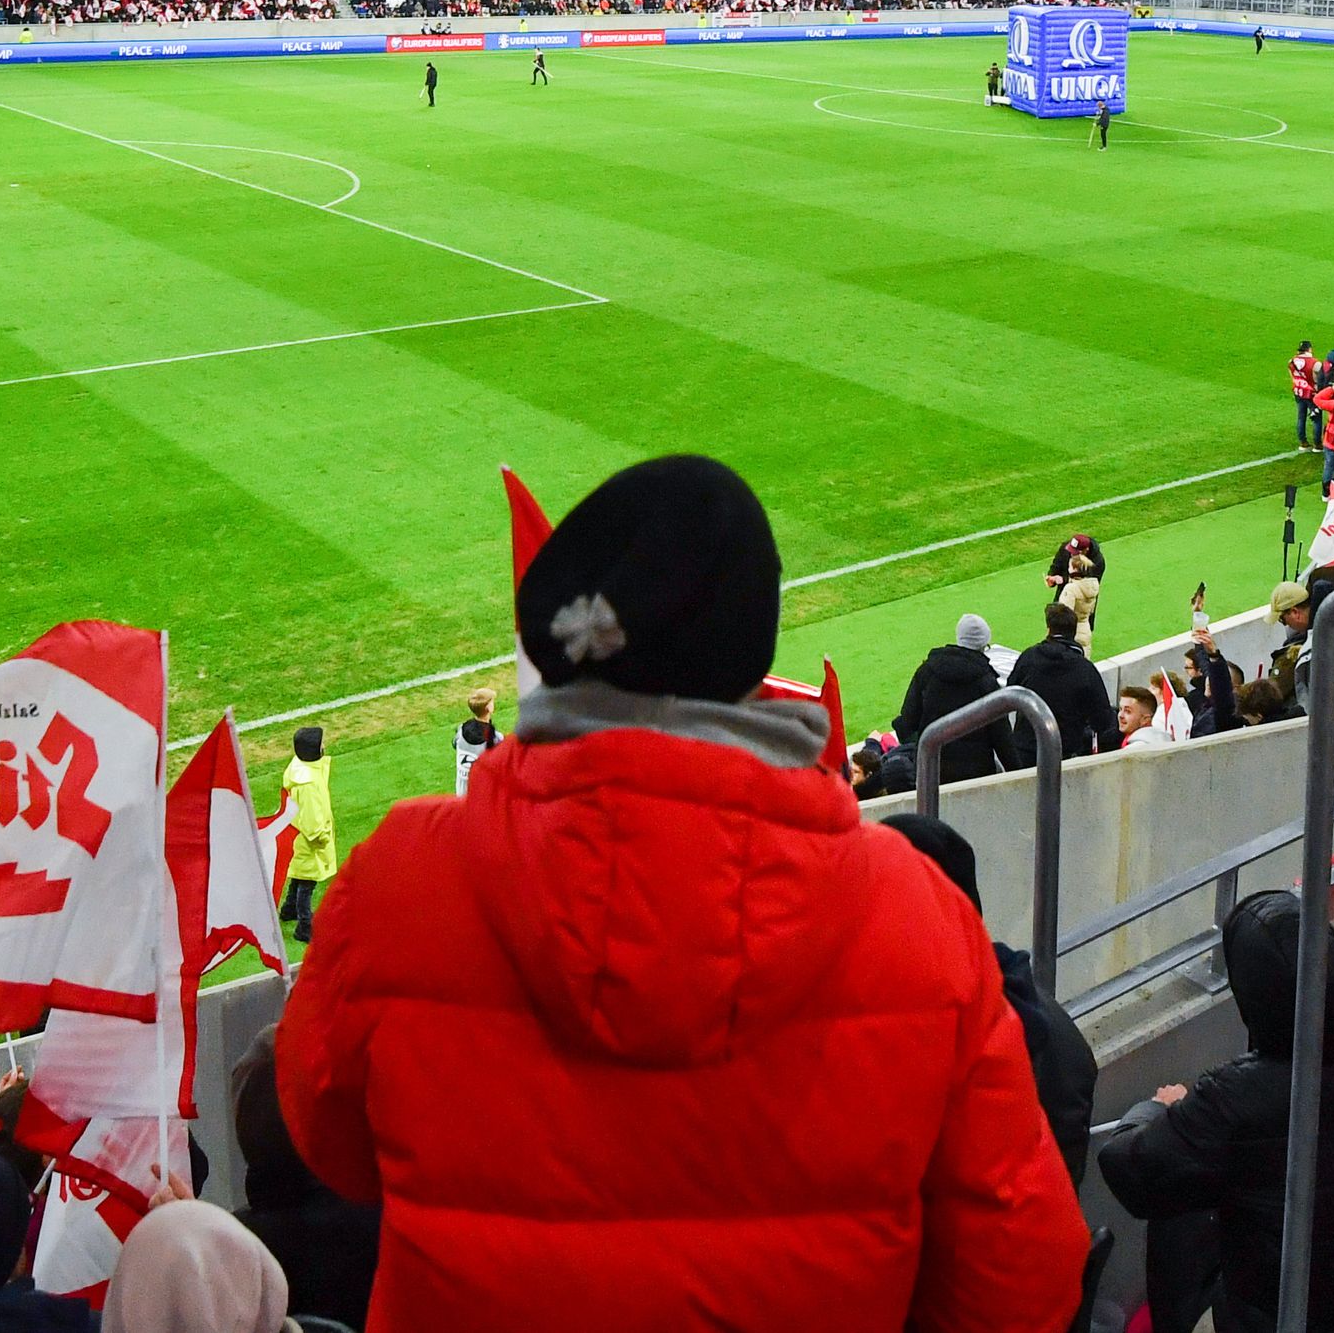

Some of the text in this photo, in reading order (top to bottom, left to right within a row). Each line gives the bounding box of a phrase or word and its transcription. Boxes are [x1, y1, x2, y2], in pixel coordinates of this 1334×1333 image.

[594, 33, 662, 43] EUROPEAN QUALIFIERS
[698, 32, 720, 40] PEACE
[806, 29, 824, 37] PEACE
[282, 42, 312, 52] PEACE
[321, 41, 343, 51] МИР
[404, 38, 482, 48] EUROPEAN QUALIFIERS
[119, 46, 153, 56] PEACE
[163, 45, 187, 54] МИР
